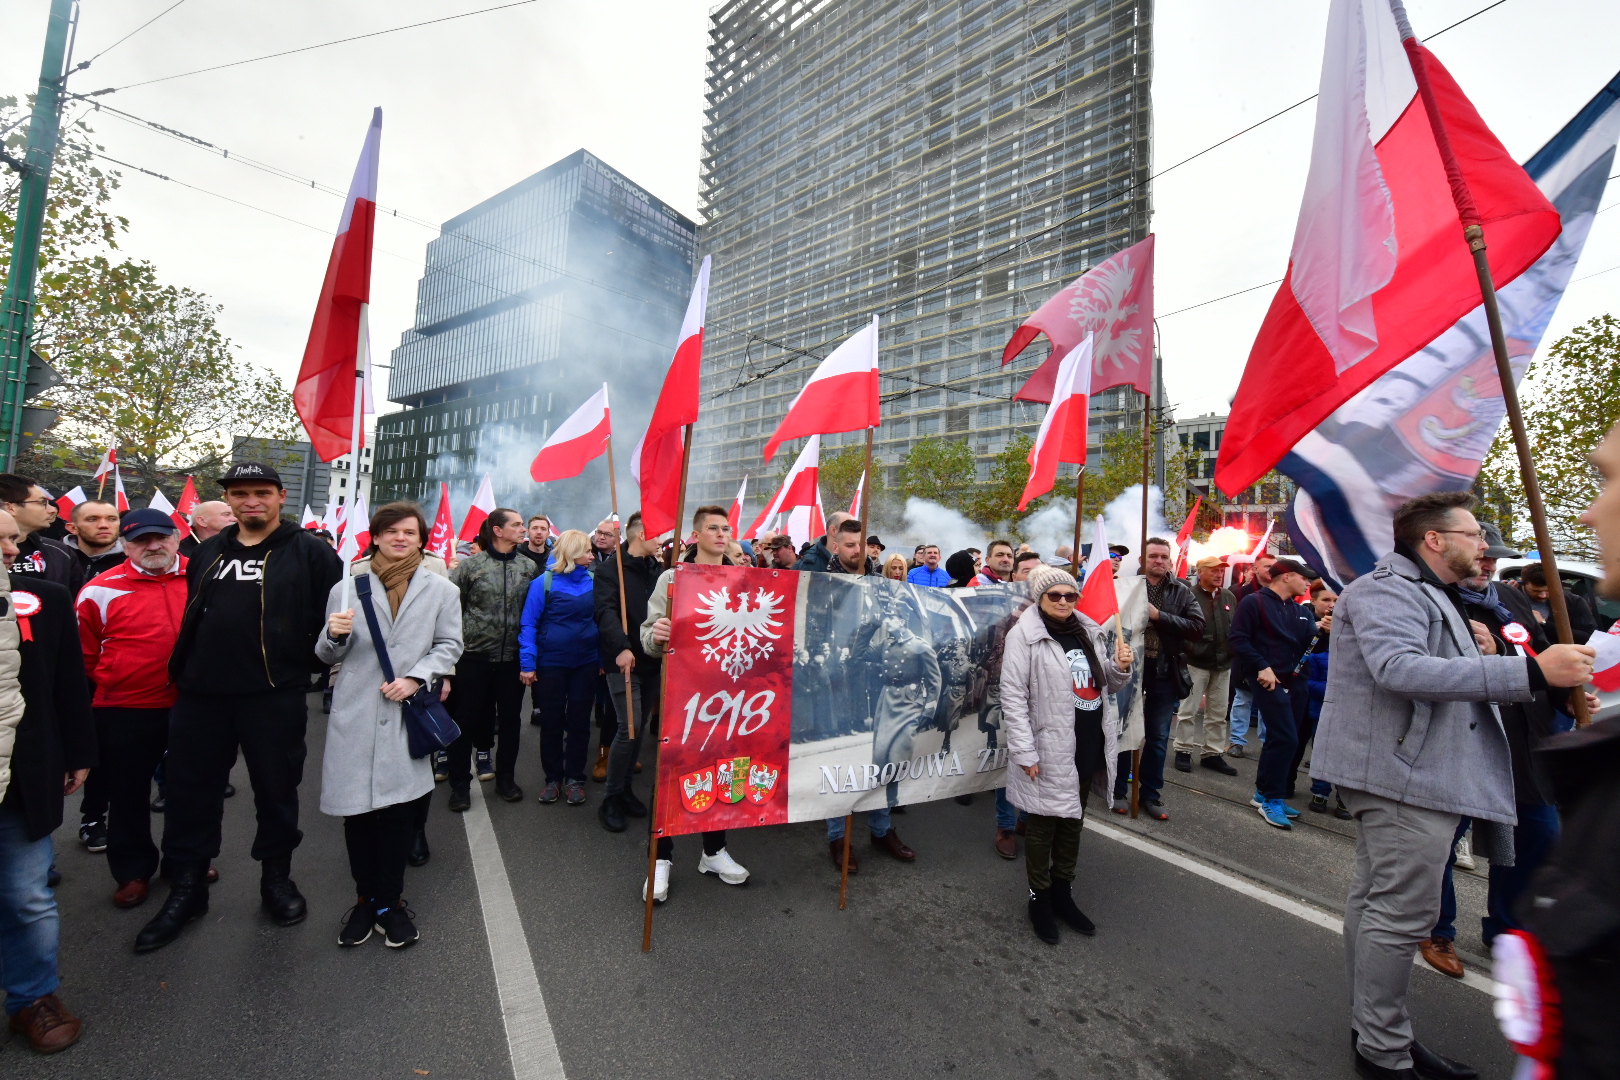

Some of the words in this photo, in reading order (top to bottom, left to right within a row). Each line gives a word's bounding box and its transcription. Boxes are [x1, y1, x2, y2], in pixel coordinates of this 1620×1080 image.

[597, 164, 650, 205] ROCKWOOL
[681, 690, 776, 752] 1918
[819, 750, 965, 795] NARODOWA
